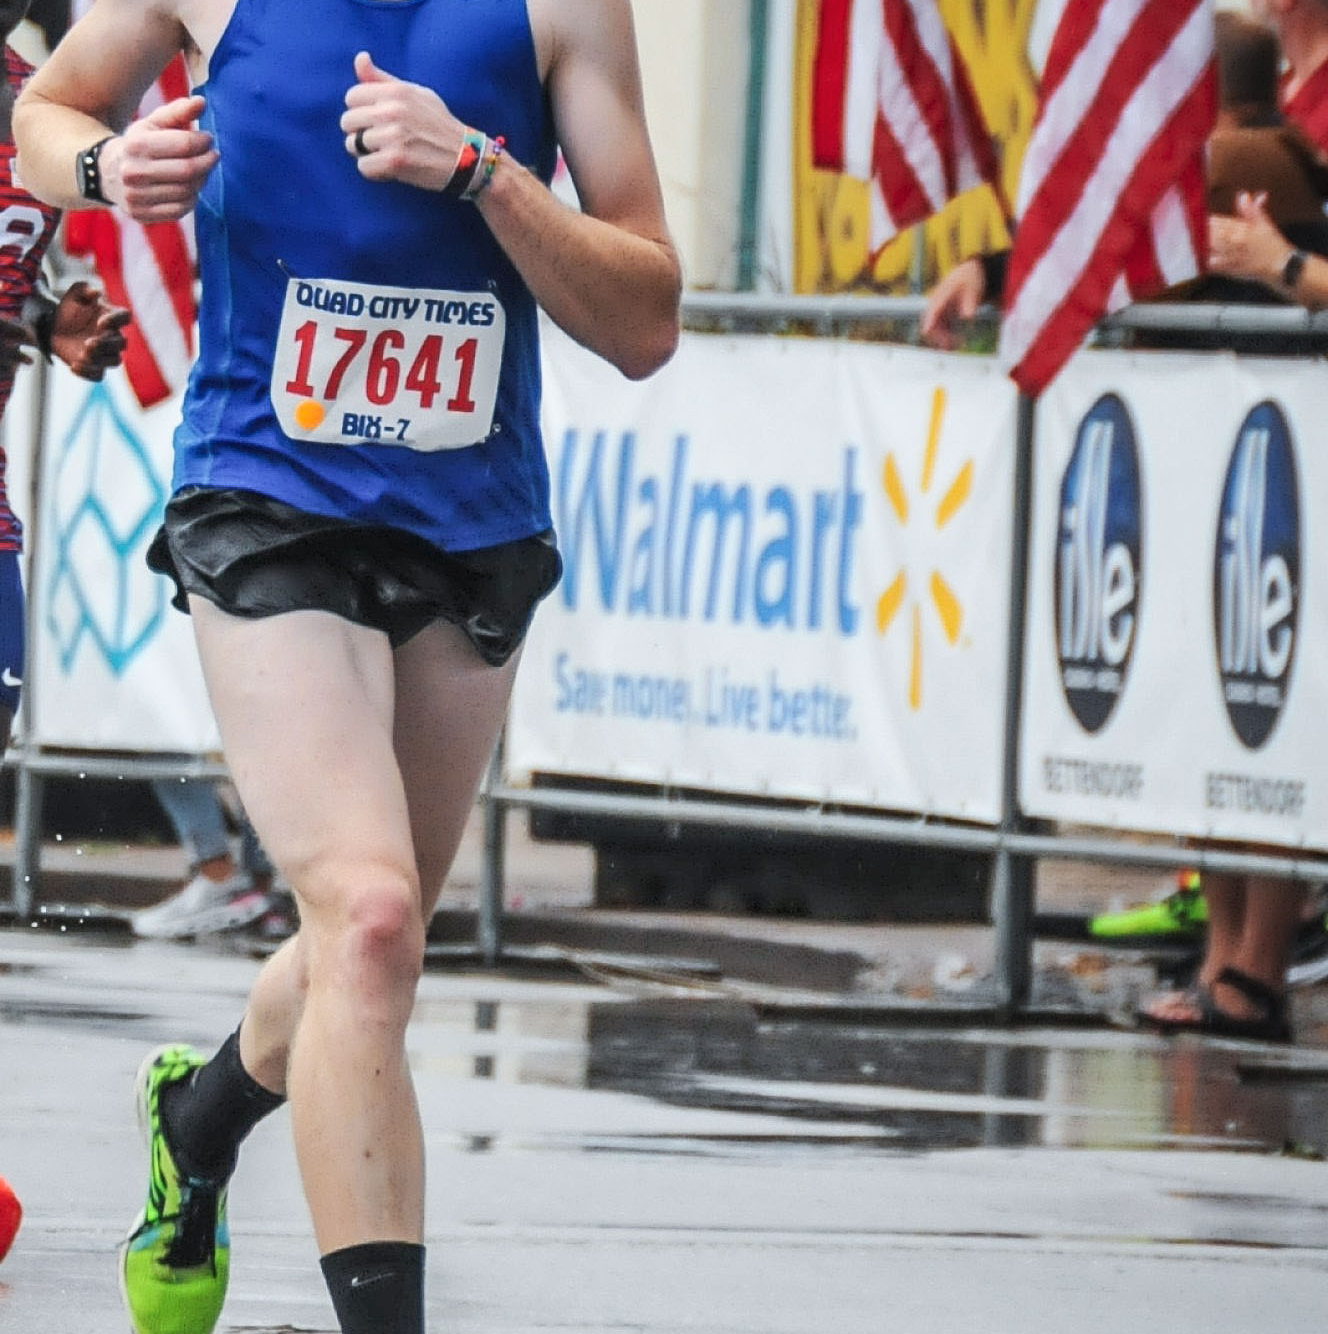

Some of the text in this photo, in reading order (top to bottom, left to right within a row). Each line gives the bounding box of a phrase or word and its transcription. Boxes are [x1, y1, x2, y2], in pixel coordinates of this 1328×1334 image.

[296, 284, 495, 327] QUAD CITY TIMES
[285, 320, 478, 413] 17641
[341, 412, 411, 441] BIX-7
[557, 427, 865, 636] Walmart
[612, 671, 702, 727] mone.
